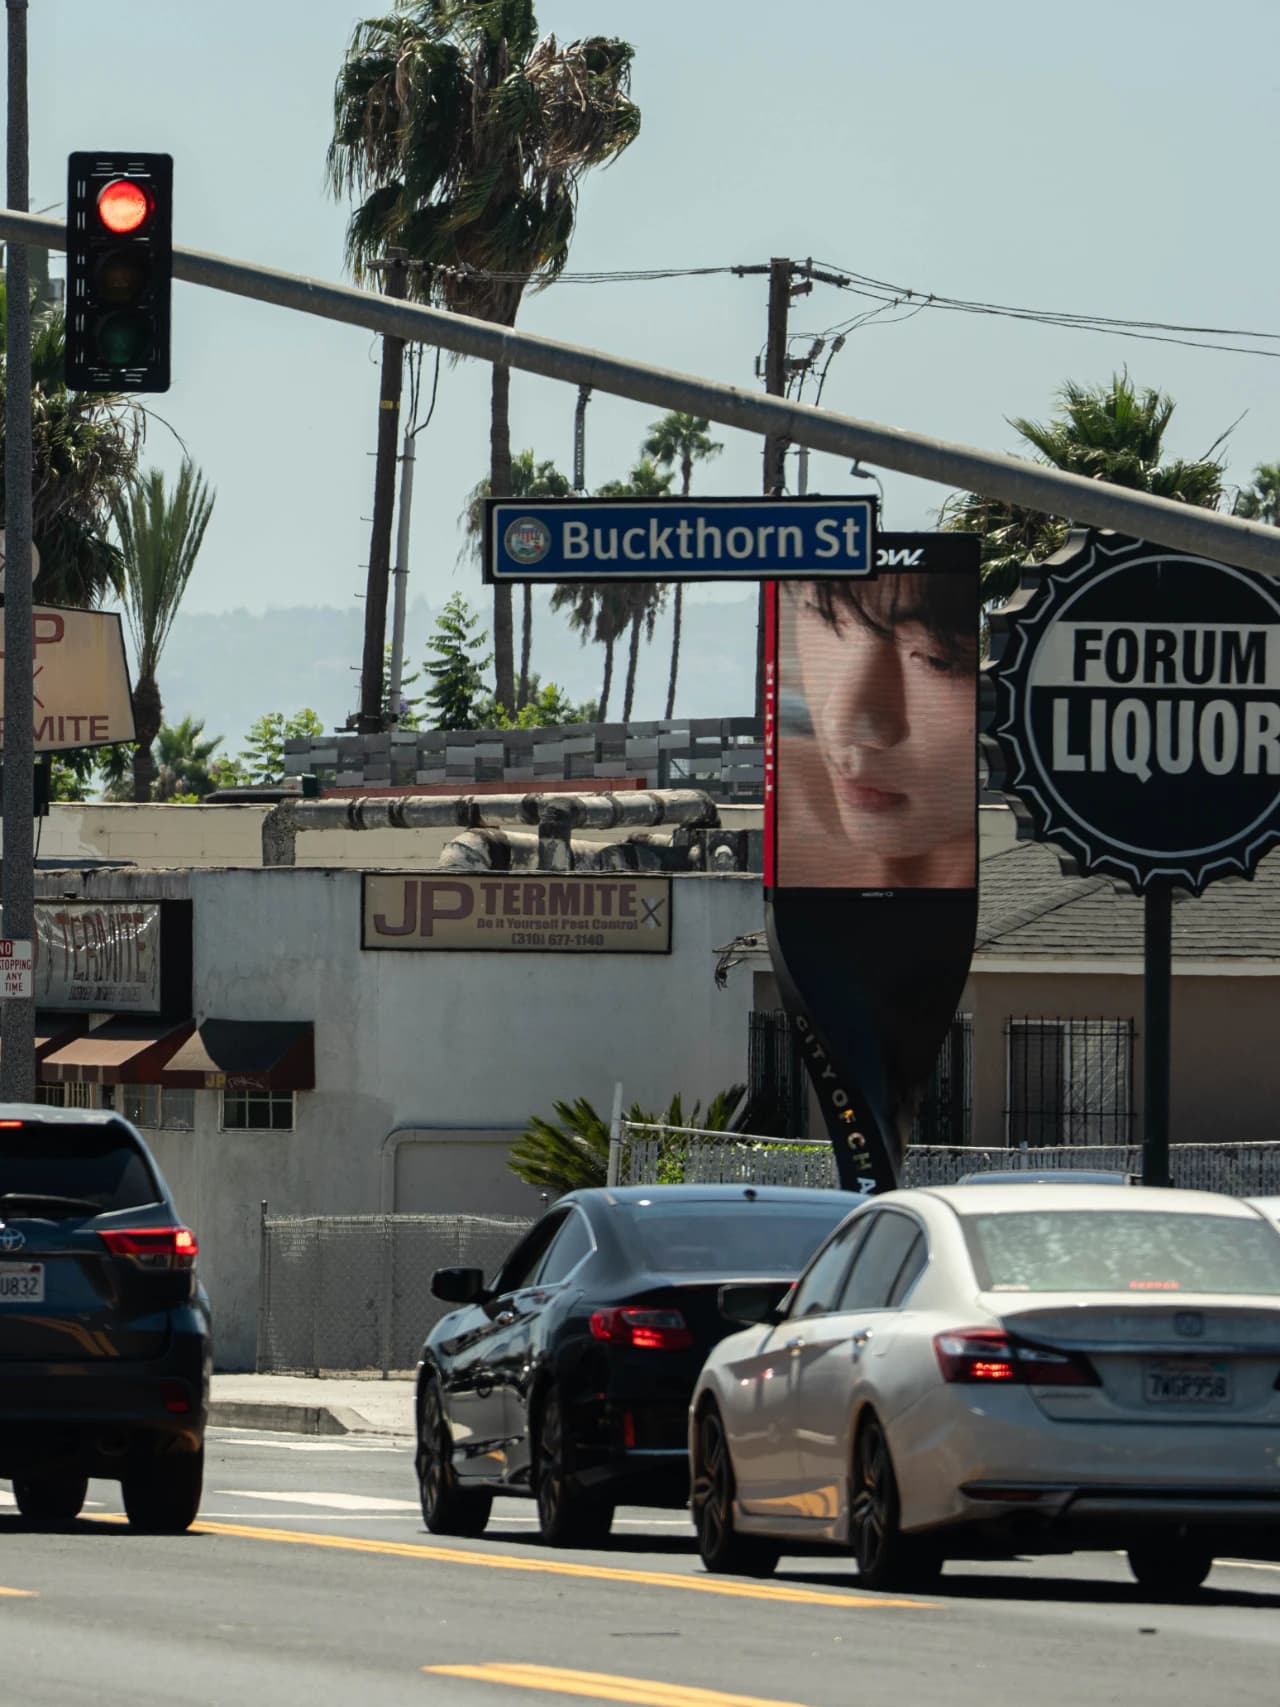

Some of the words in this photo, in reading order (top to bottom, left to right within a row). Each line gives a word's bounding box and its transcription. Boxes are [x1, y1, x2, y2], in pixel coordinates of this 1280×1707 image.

[562, 517, 804, 562] Buckthorn
[815, 517, 860, 558] St
[1073, 628, 1267, 685] FORUM
[1052, 698, 1280, 784] LIQUOR
[373, 879, 476, 937] JP
[480, 882, 638, 918] TERMITE
[506, 917, 558, 930] Yourself
[561, 918, 590, 930] Pest
[592, 918, 639, 931] Control
[5, 982, 24, 993] TIME
[6, 972, 23, 982] ANY
[796, 1015, 837, 1078] CITY
